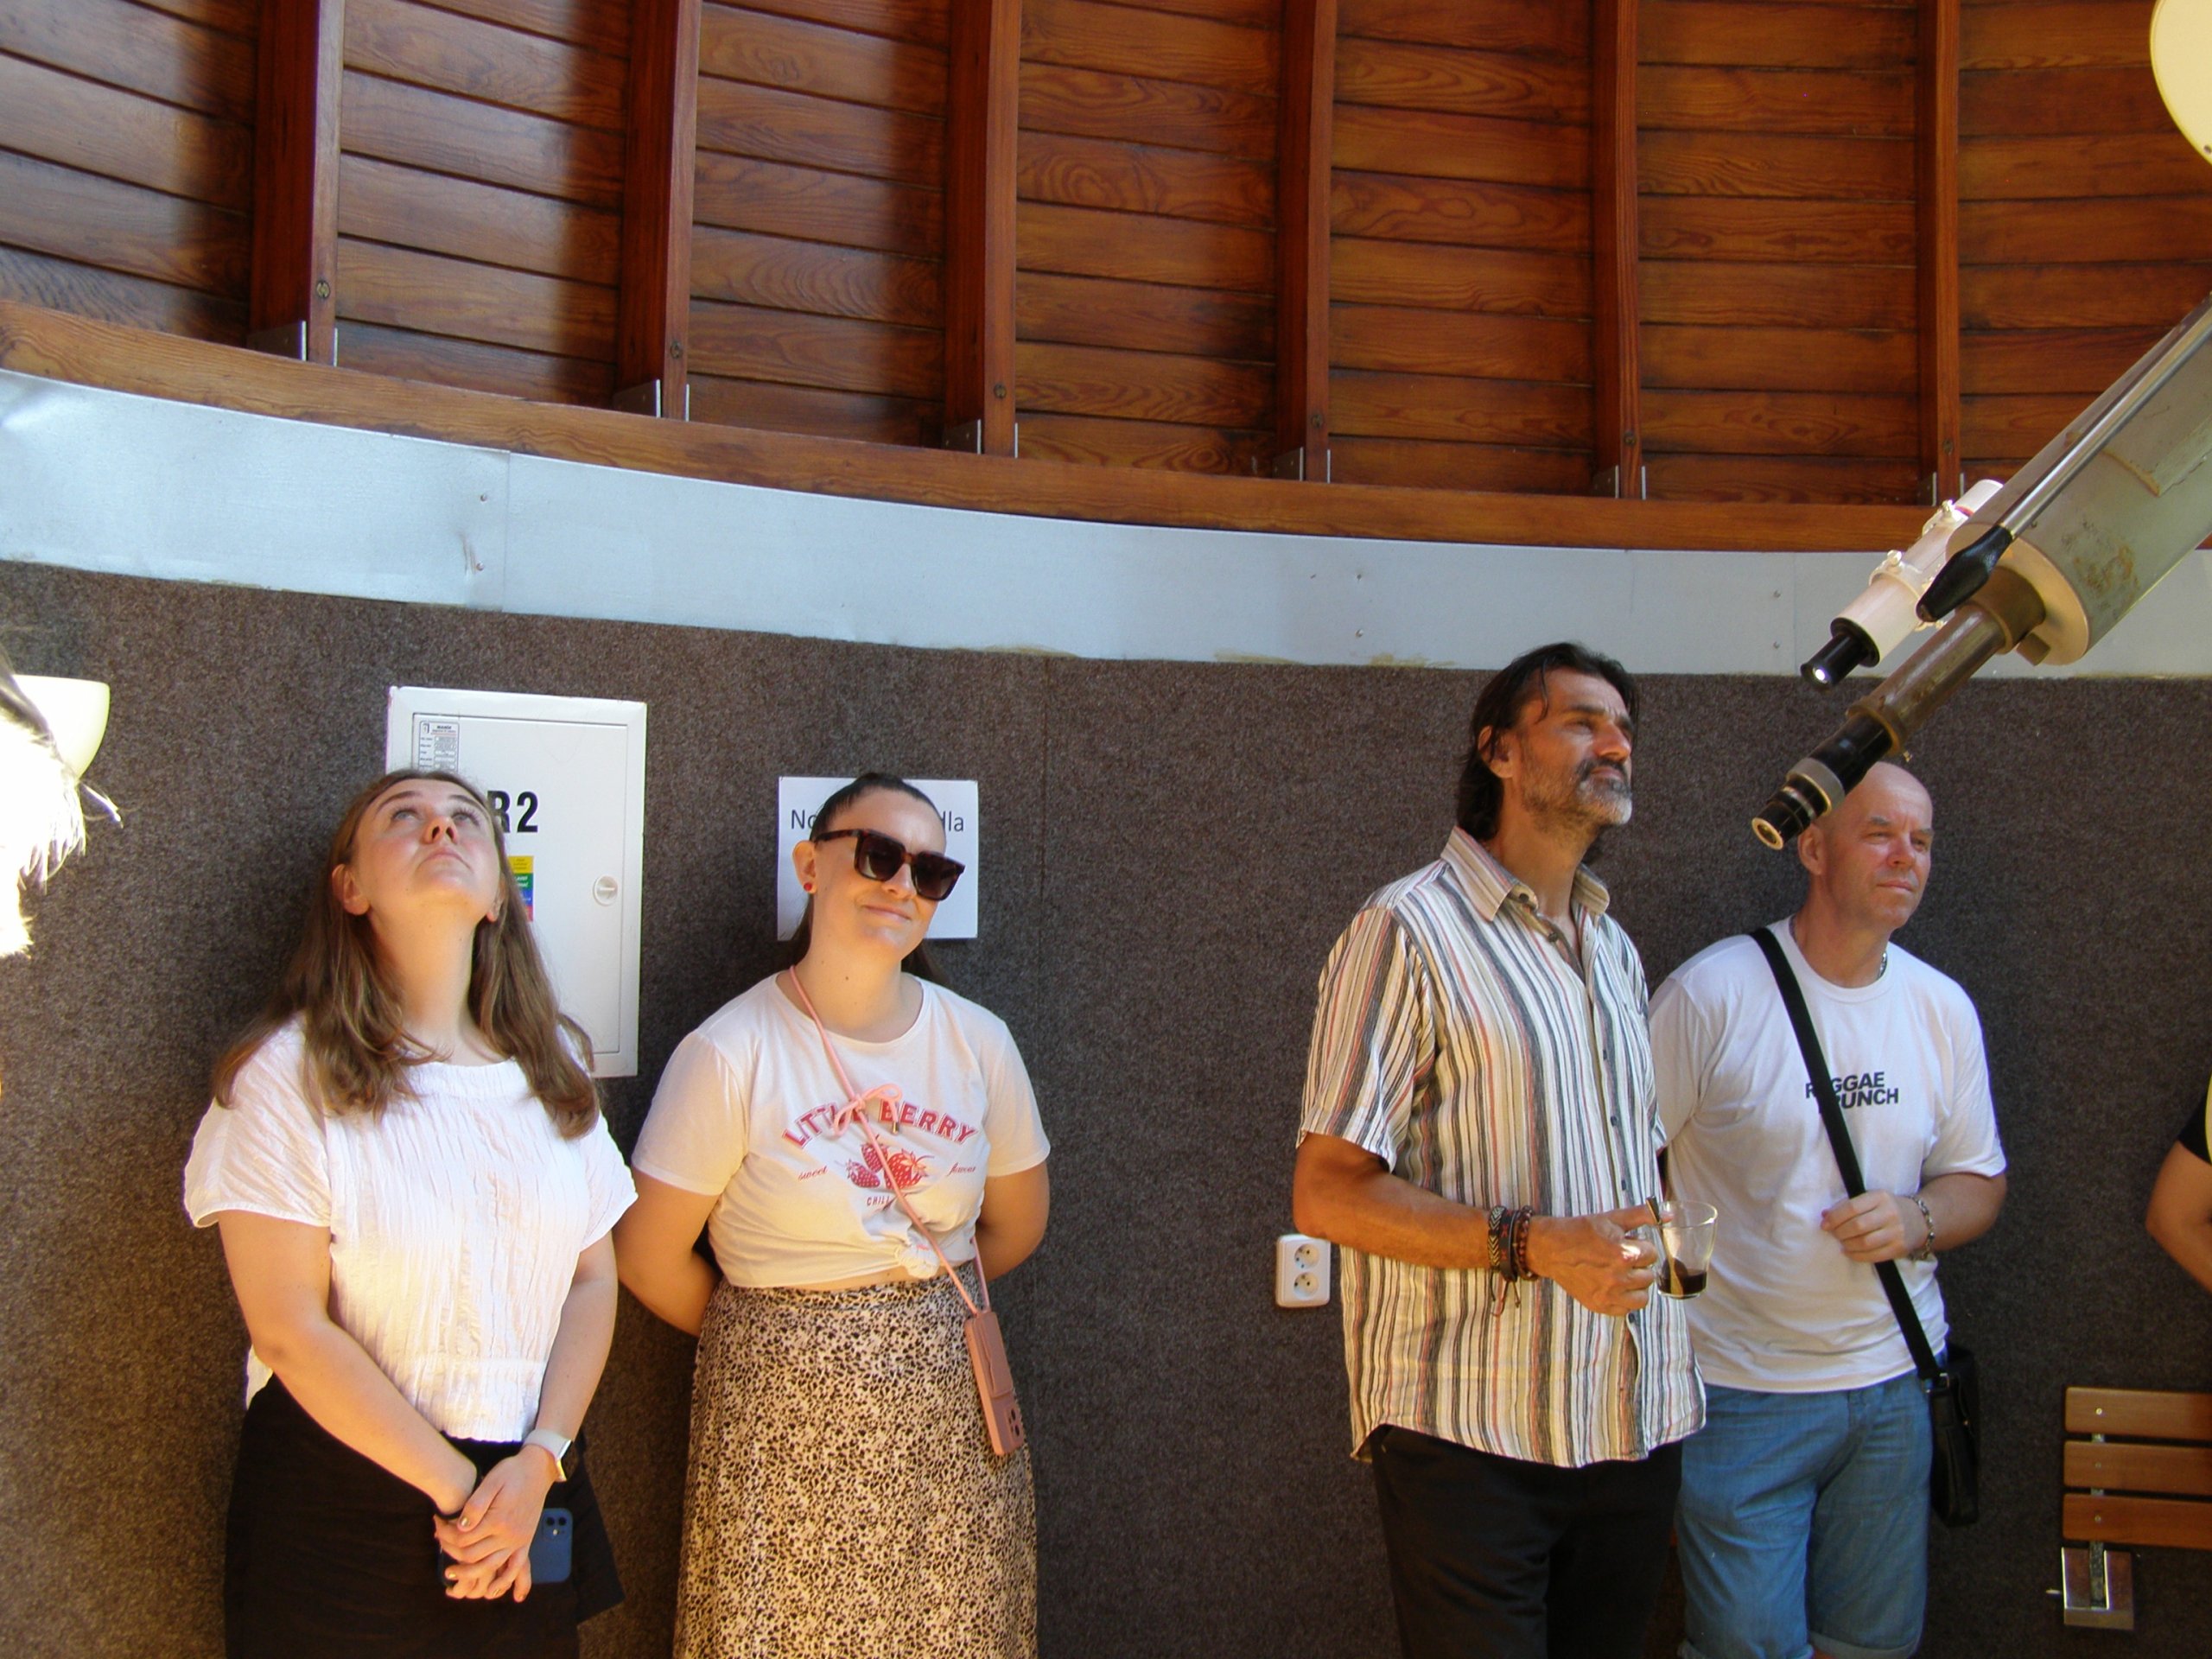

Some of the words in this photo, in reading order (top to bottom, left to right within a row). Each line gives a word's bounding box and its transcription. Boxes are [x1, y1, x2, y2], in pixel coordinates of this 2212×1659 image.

[486, 790, 539, 833] R2
[791, 809, 816, 830] No
[943, 810, 963, 831] lla
[1805, 1071, 1885, 1099] RGGAE
[1834, 1088, 1899, 1109] UNCH
[878, 1098, 978, 1145] BERRY
